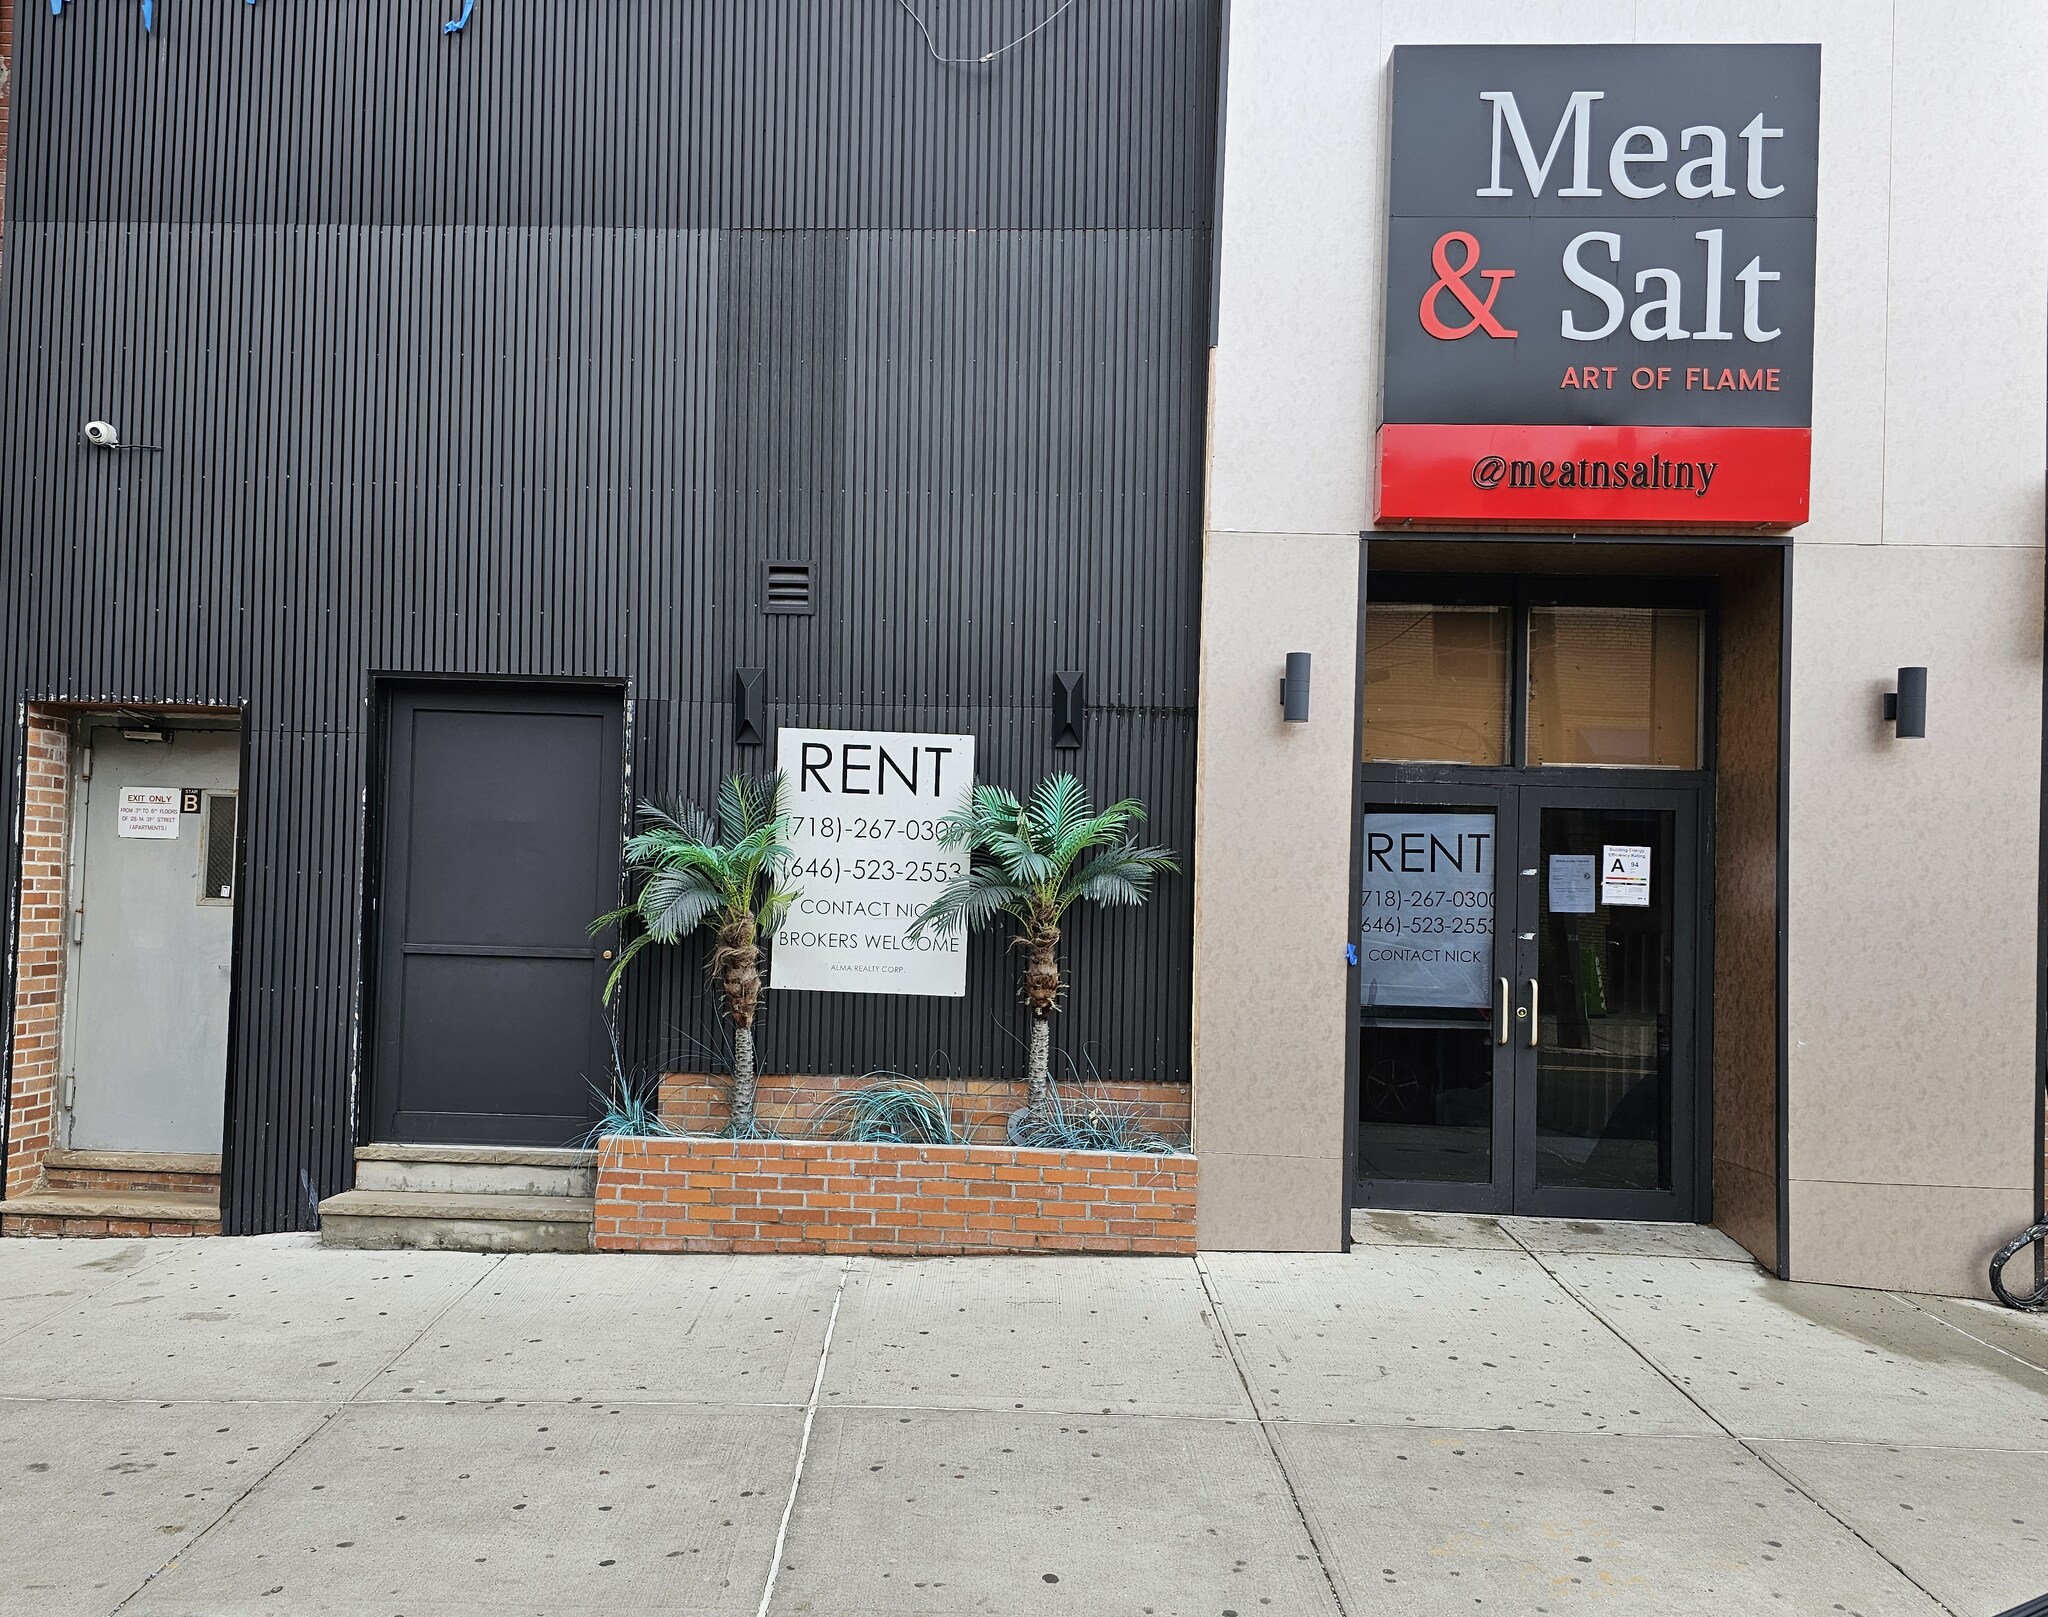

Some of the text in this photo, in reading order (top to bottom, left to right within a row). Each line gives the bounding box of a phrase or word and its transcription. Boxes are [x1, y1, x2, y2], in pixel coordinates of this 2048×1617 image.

[1476, 91, 1785, 199] Meat
[1419, 229, 1782, 342] & Salt
[1560, 367, 1780, 391] ART OF FLAME
[1471, 454, 1718, 496] @meatnsaltny
[800, 742, 952, 797] RENT
[184, 795, 198, 812] B
[1367, 832, 1491, 874] RENT
[783, 857, 961, 884] (646)-523-2553
[1610, 858, 1625, 873] A
[800, 900, 929, 917] CONTACT NIC
[779, 932, 960, 952] BROKERS WELCOME
[1368, 949, 1481, 963] CONTACT NICK
[830, 964, 906, 974] ALMA REALTY CORP.
